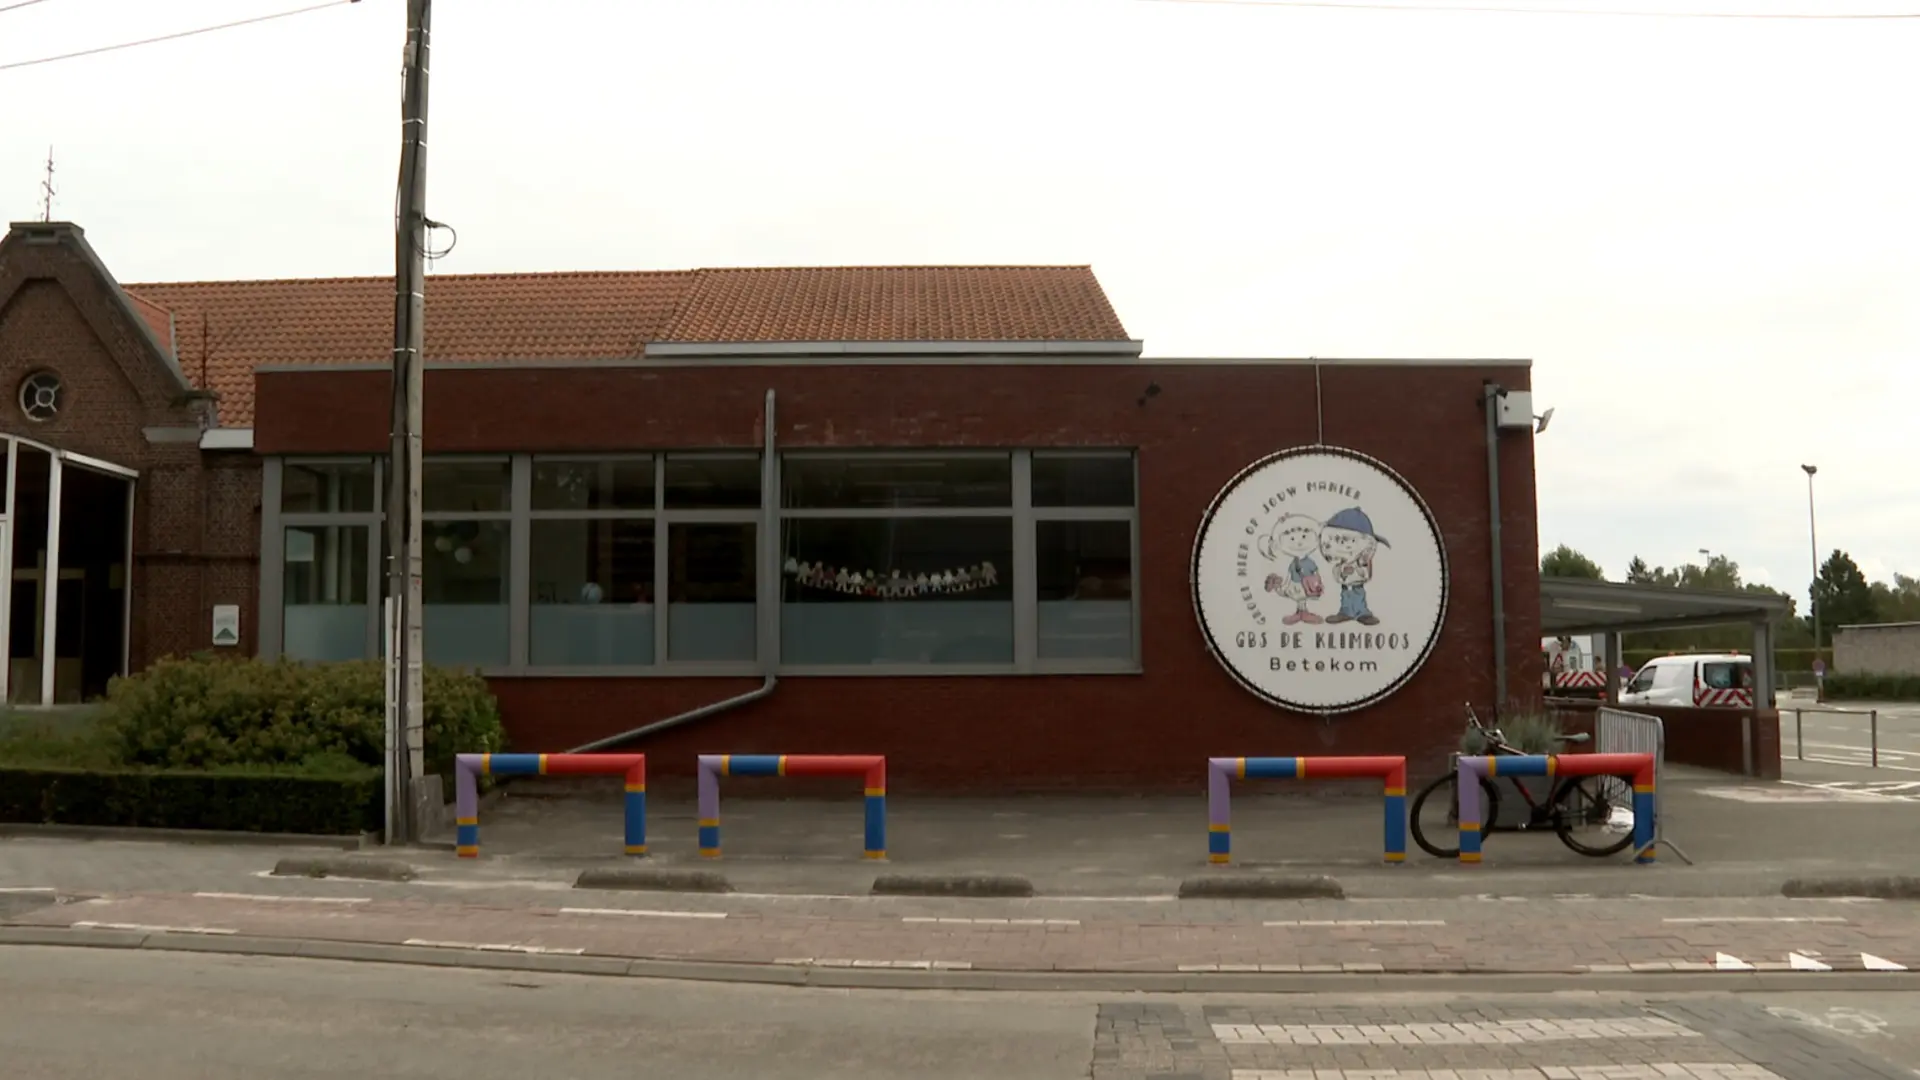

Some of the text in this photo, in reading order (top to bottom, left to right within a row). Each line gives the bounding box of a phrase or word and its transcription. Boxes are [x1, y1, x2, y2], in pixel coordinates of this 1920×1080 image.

[1237, 543, 1249, 577] HIER
[1245, 518, 1259, 535] OP
[1262, 486, 1297, 514] JOUW
[1306, 481, 1361, 500] MANIER
[1235, 631, 1410, 650] GBS DE KLIMROOS
[1270, 656, 1378, 672] Betekom
